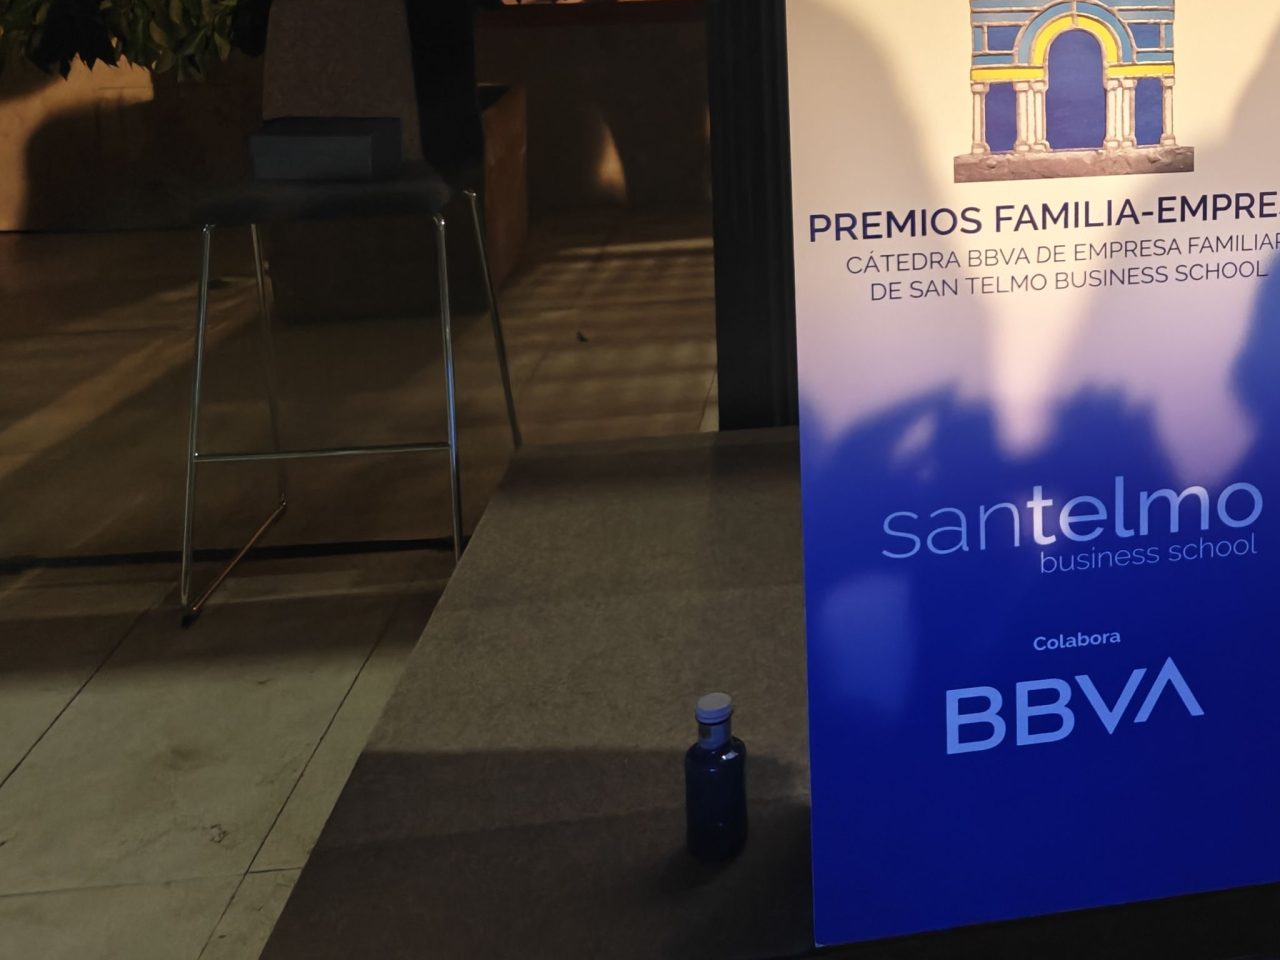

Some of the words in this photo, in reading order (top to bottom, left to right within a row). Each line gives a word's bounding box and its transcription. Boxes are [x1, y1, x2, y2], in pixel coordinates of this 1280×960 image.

[808, 206, 983, 243] PREMIOS
[845, 248, 962, 275] CÁTEDRA
[967, 246, 1031, 268] BBVA
[1035, 244, 1067, 265] DE
[1073, 237, 1183, 262] EMPRESA
[870, 280, 904, 302] DE
[908, 277, 959, 300] SAN
[964, 272, 1048, 296] TELMO
[1054, 264, 1169, 290] BUSINESS
[1174, 259, 1269, 283] SCHOOL
[881, 475, 1264, 559] santelmo
[1039, 546, 1161, 575] business
[1167, 531, 1258, 563] school
[1032, 631, 1122, 652] Colabora
[945, 656, 1206, 756] BBVA
